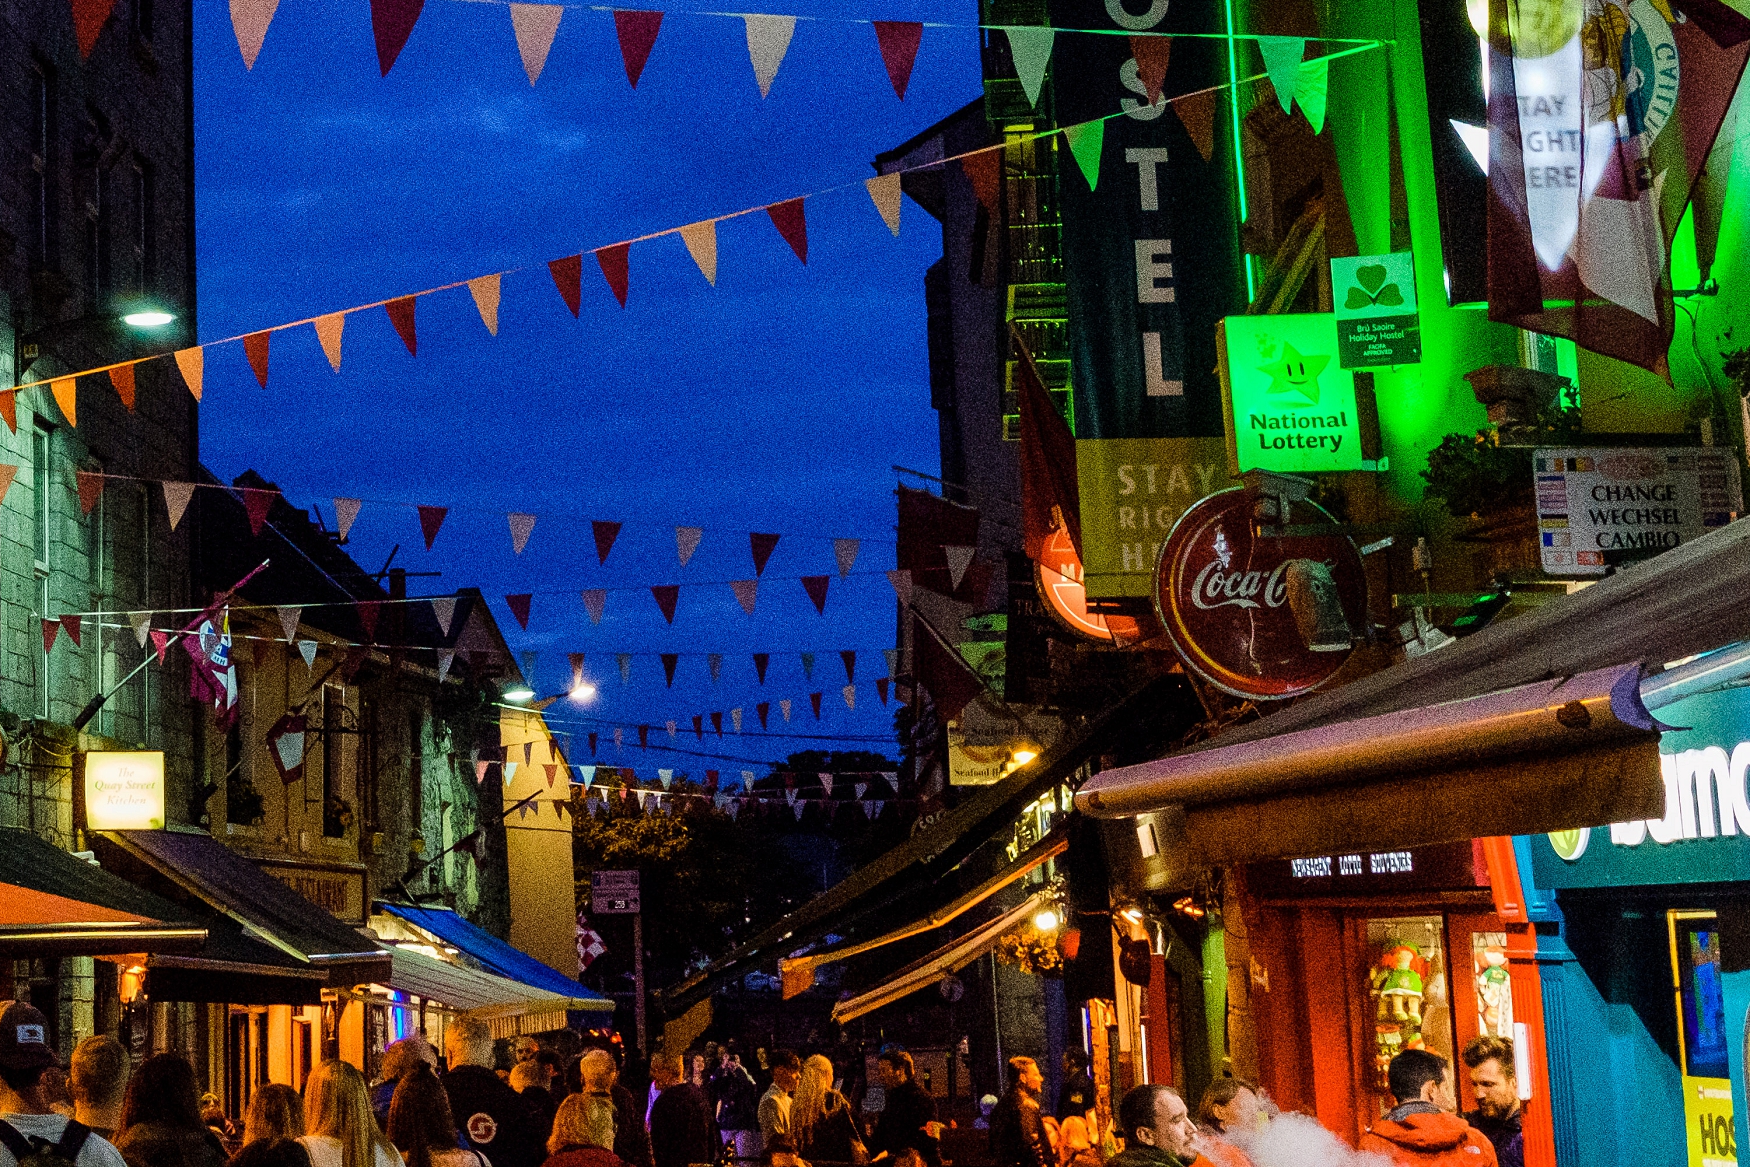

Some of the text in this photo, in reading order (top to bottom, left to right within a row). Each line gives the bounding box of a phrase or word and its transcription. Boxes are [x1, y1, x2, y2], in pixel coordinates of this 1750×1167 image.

[1517, 95, 1566, 117] TAY
[1526, 129, 1580, 152] GHT
[1529, 166, 1578, 188] ERE
[1349, 330, 1404, 342] Holiday Hostel
[1250, 411, 1348, 430] National
[1258, 433, 1343, 453] Lottery
[1117, 464, 1216, 496] STAY
[1591, 484, 1678, 502] CHANGE
[1119, 505, 1187, 530] RIG
[1588, 508, 1683, 526] WECHSEL
[1596, 531, 1680, 549] CAMBIO
[1191, 558, 1293, 610] Coca-C
[118, 766, 135, 778] The
[94, 780, 156, 792] Quay Street
[107, 794, 147, 805] Kitchen
